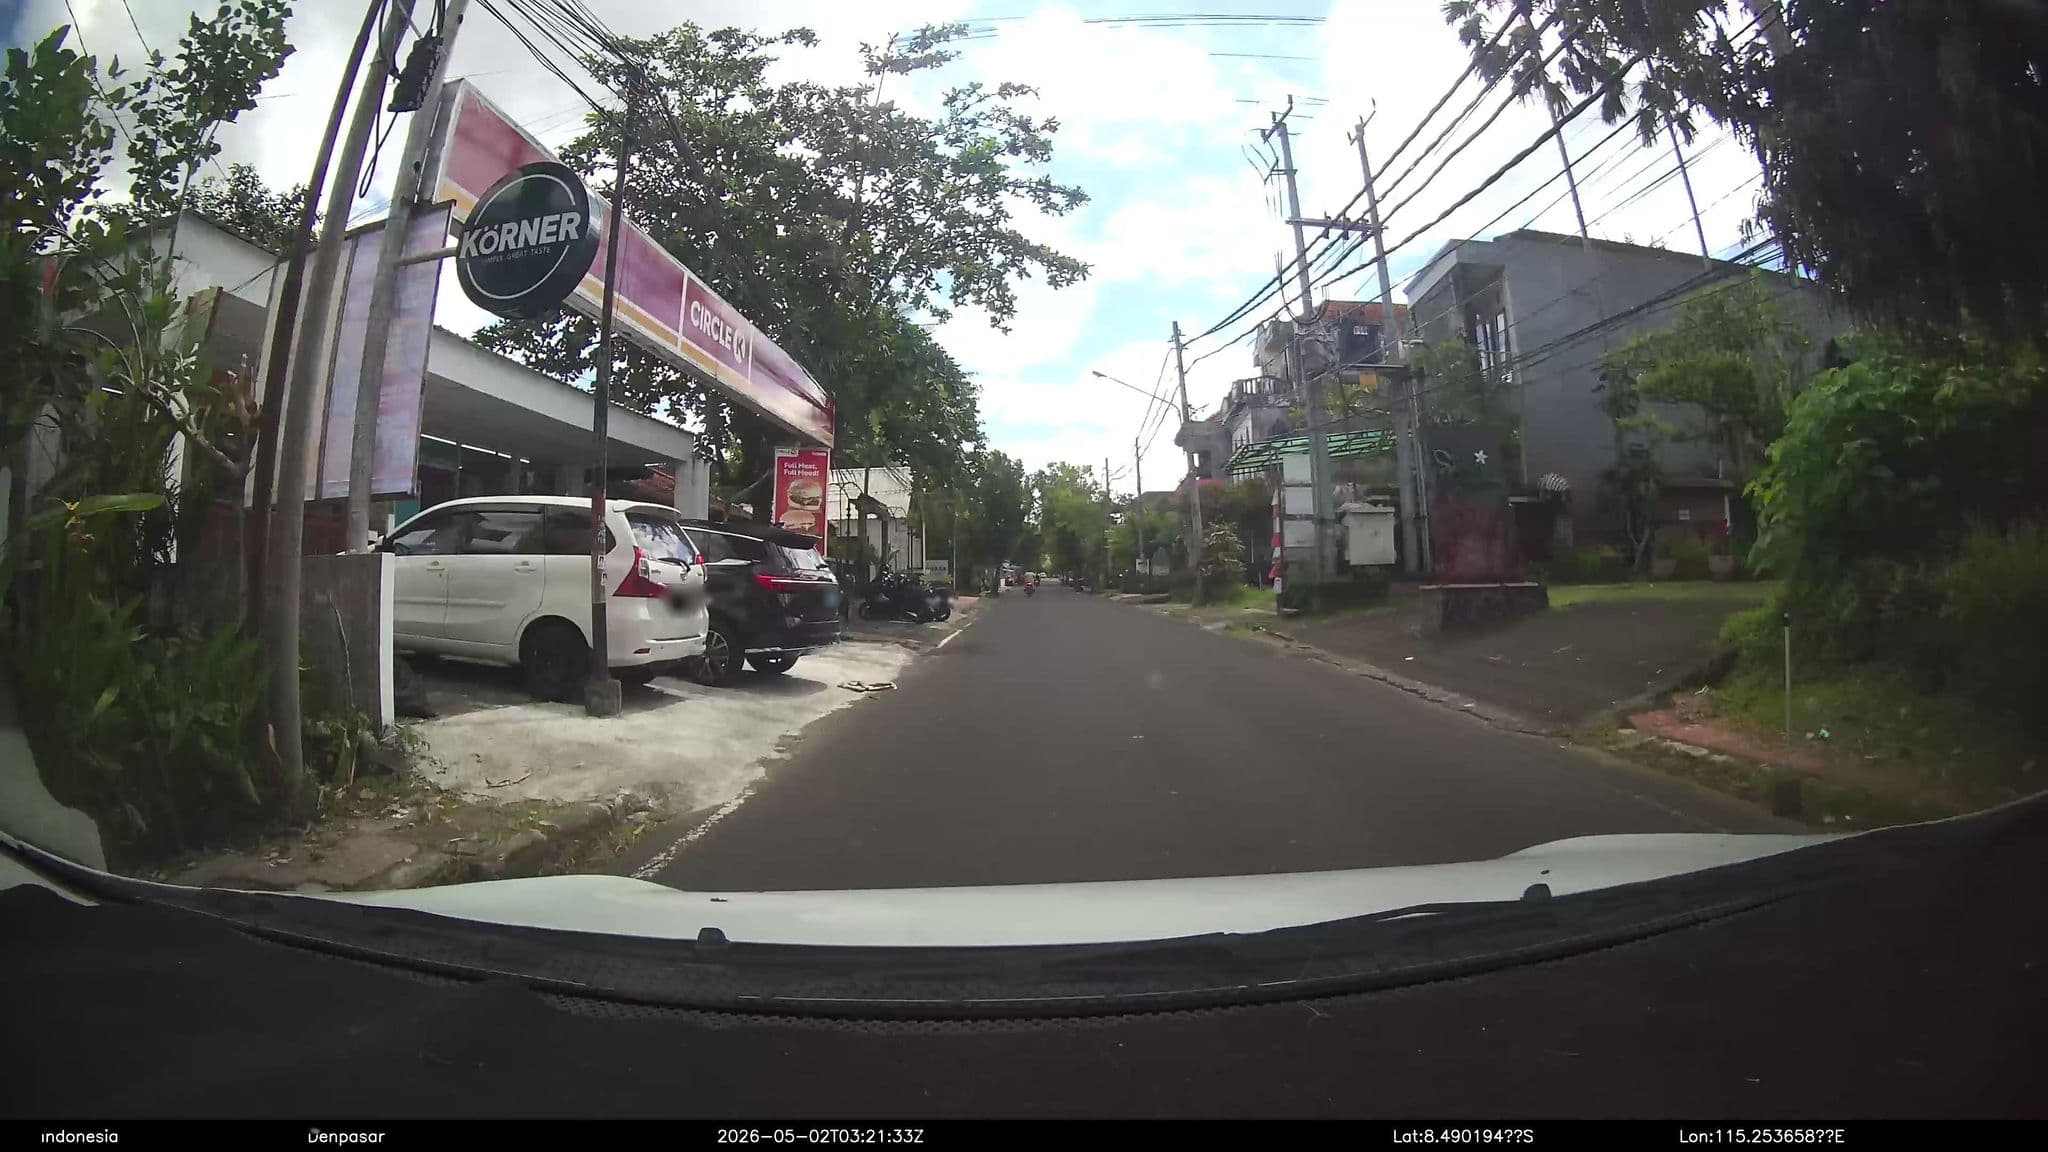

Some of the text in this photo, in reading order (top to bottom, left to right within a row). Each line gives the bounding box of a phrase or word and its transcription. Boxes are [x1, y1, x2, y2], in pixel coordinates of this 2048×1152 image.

[459, 211, 582, 259] KÖRNER
[531, 246, 552, 257] TASTE
[690, 300, 733, 351] CIRCLE
